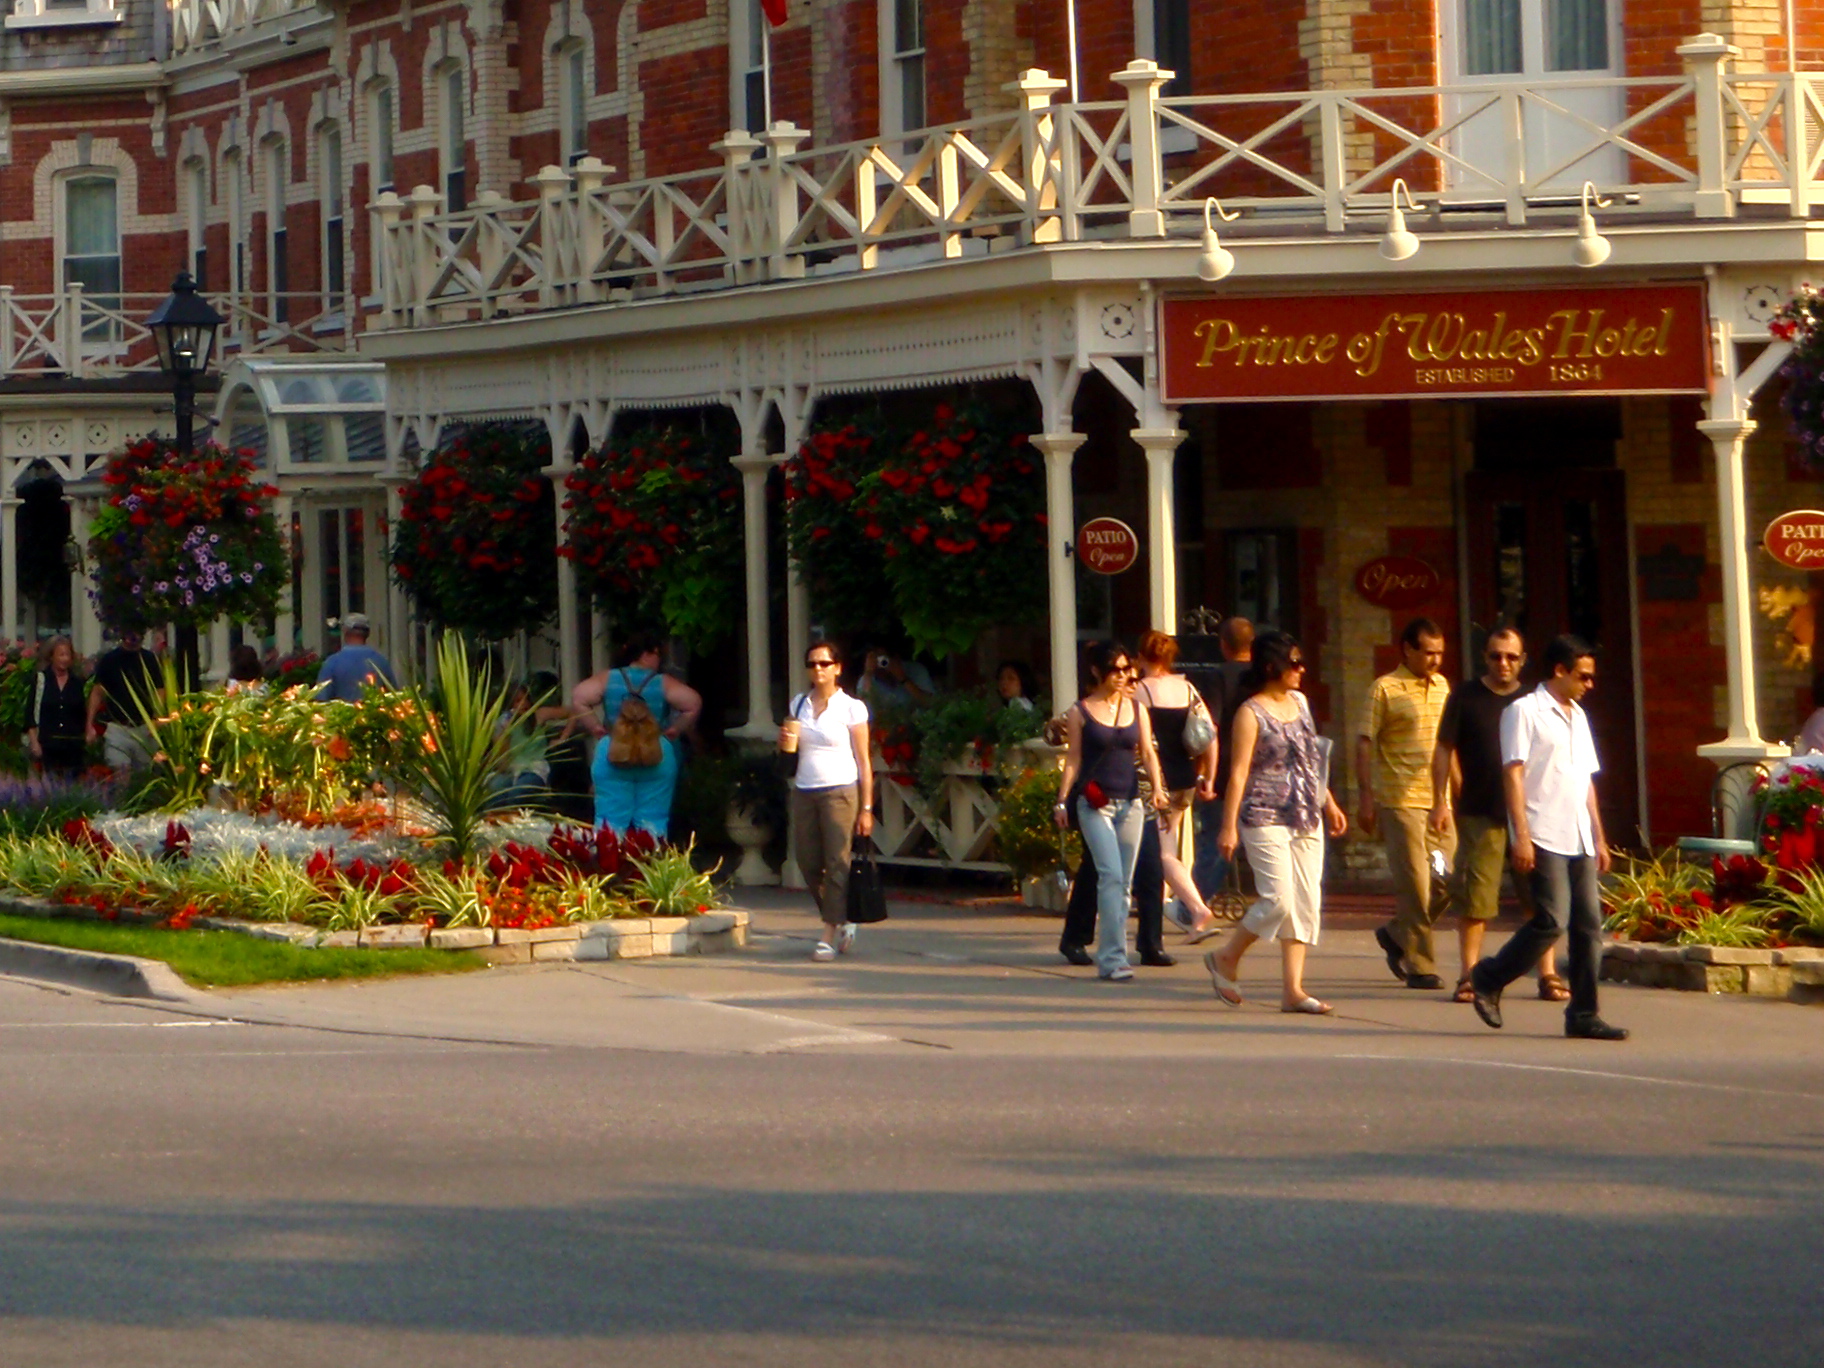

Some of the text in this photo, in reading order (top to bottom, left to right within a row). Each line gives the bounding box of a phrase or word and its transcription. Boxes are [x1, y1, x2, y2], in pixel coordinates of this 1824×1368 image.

[1194, 307, 1674, 377] Prince of Wales Hotel
[1415, 363, 1603, 384] ESTABLISHED 1864
[1086, 529, 1127, 544] PATIO
[1780, 524, 1824, 539] PATI
[1090, 547, 1125, 567] Open
[1784, 541, 1824, 563] Ope
[1363, 564, 1430, 600] Open
